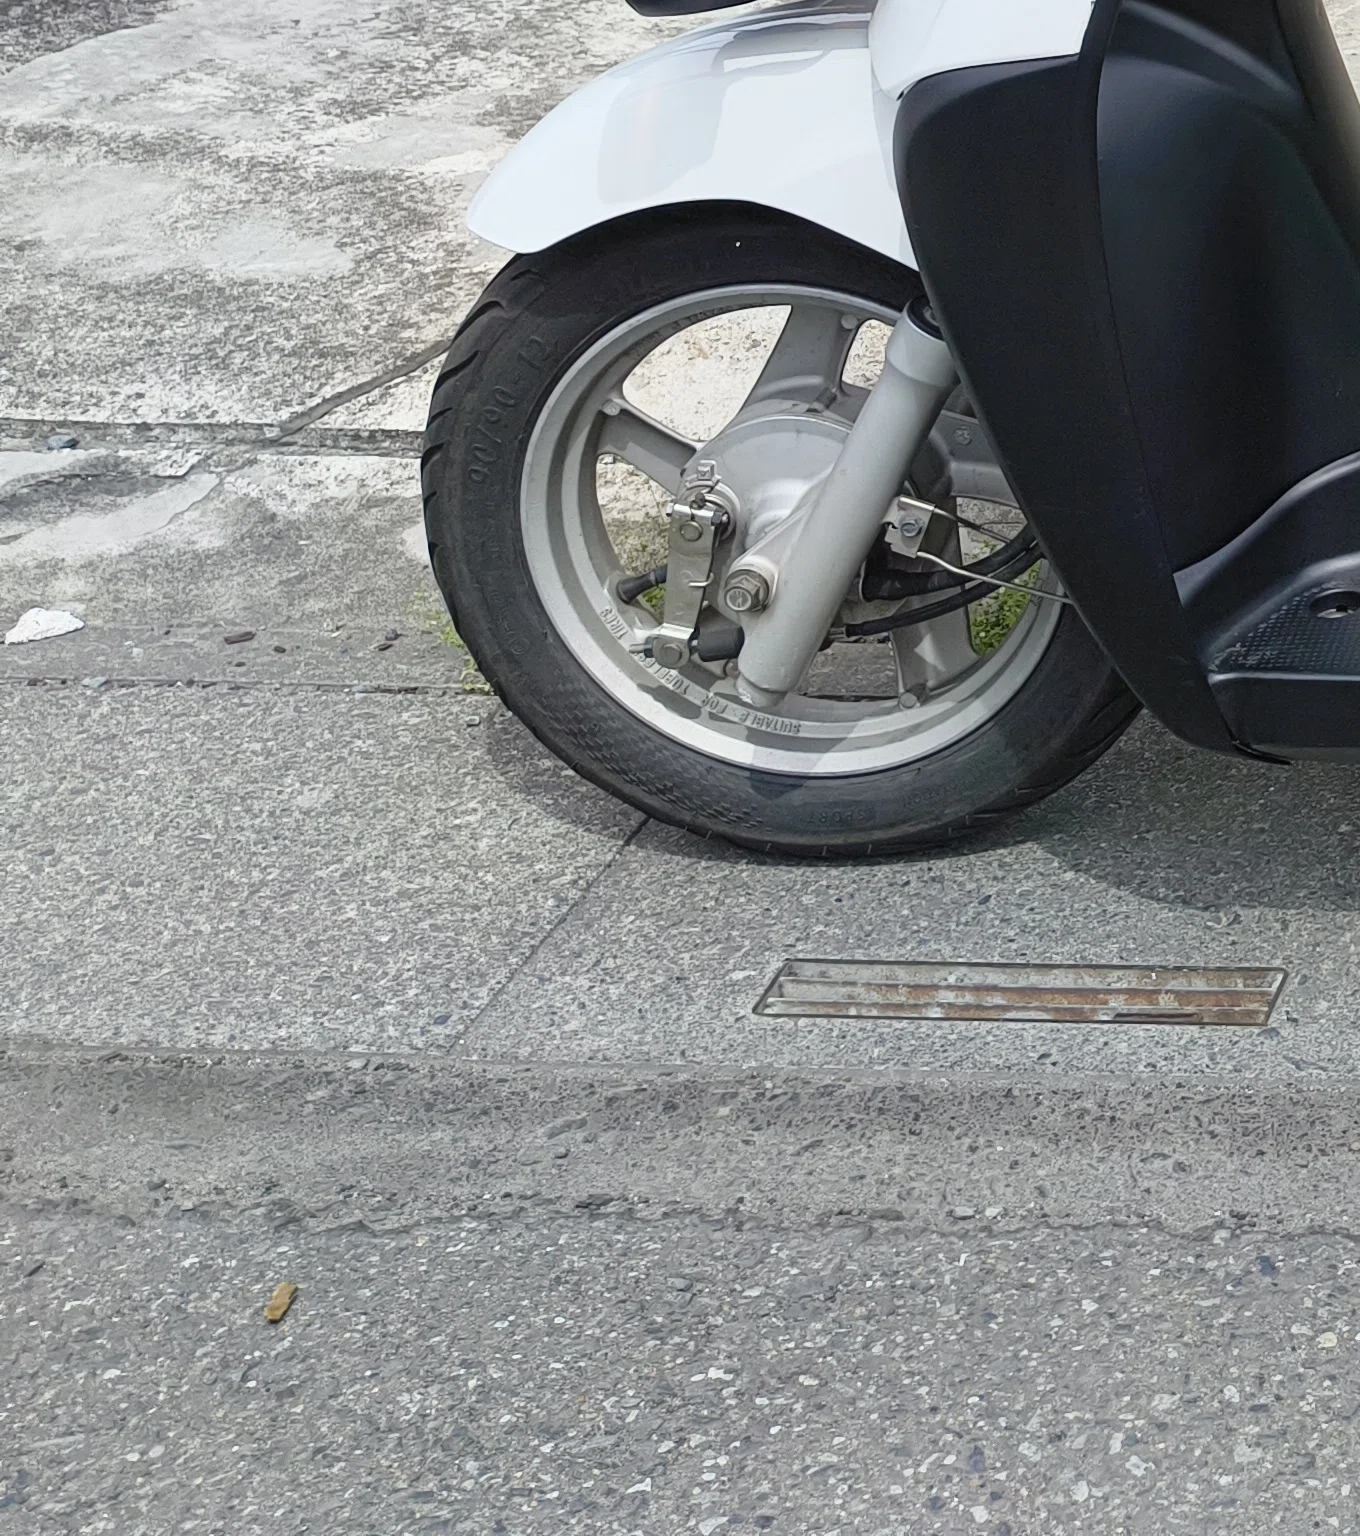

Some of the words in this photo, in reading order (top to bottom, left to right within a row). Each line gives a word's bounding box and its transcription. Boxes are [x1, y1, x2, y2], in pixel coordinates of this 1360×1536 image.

[599, 606, 630, 641] TIRES
[631, 650, 690, 696] TUBELES
[700, 693, 729, 716] FOR
[737, 713, 802, 735] SUITABLE
